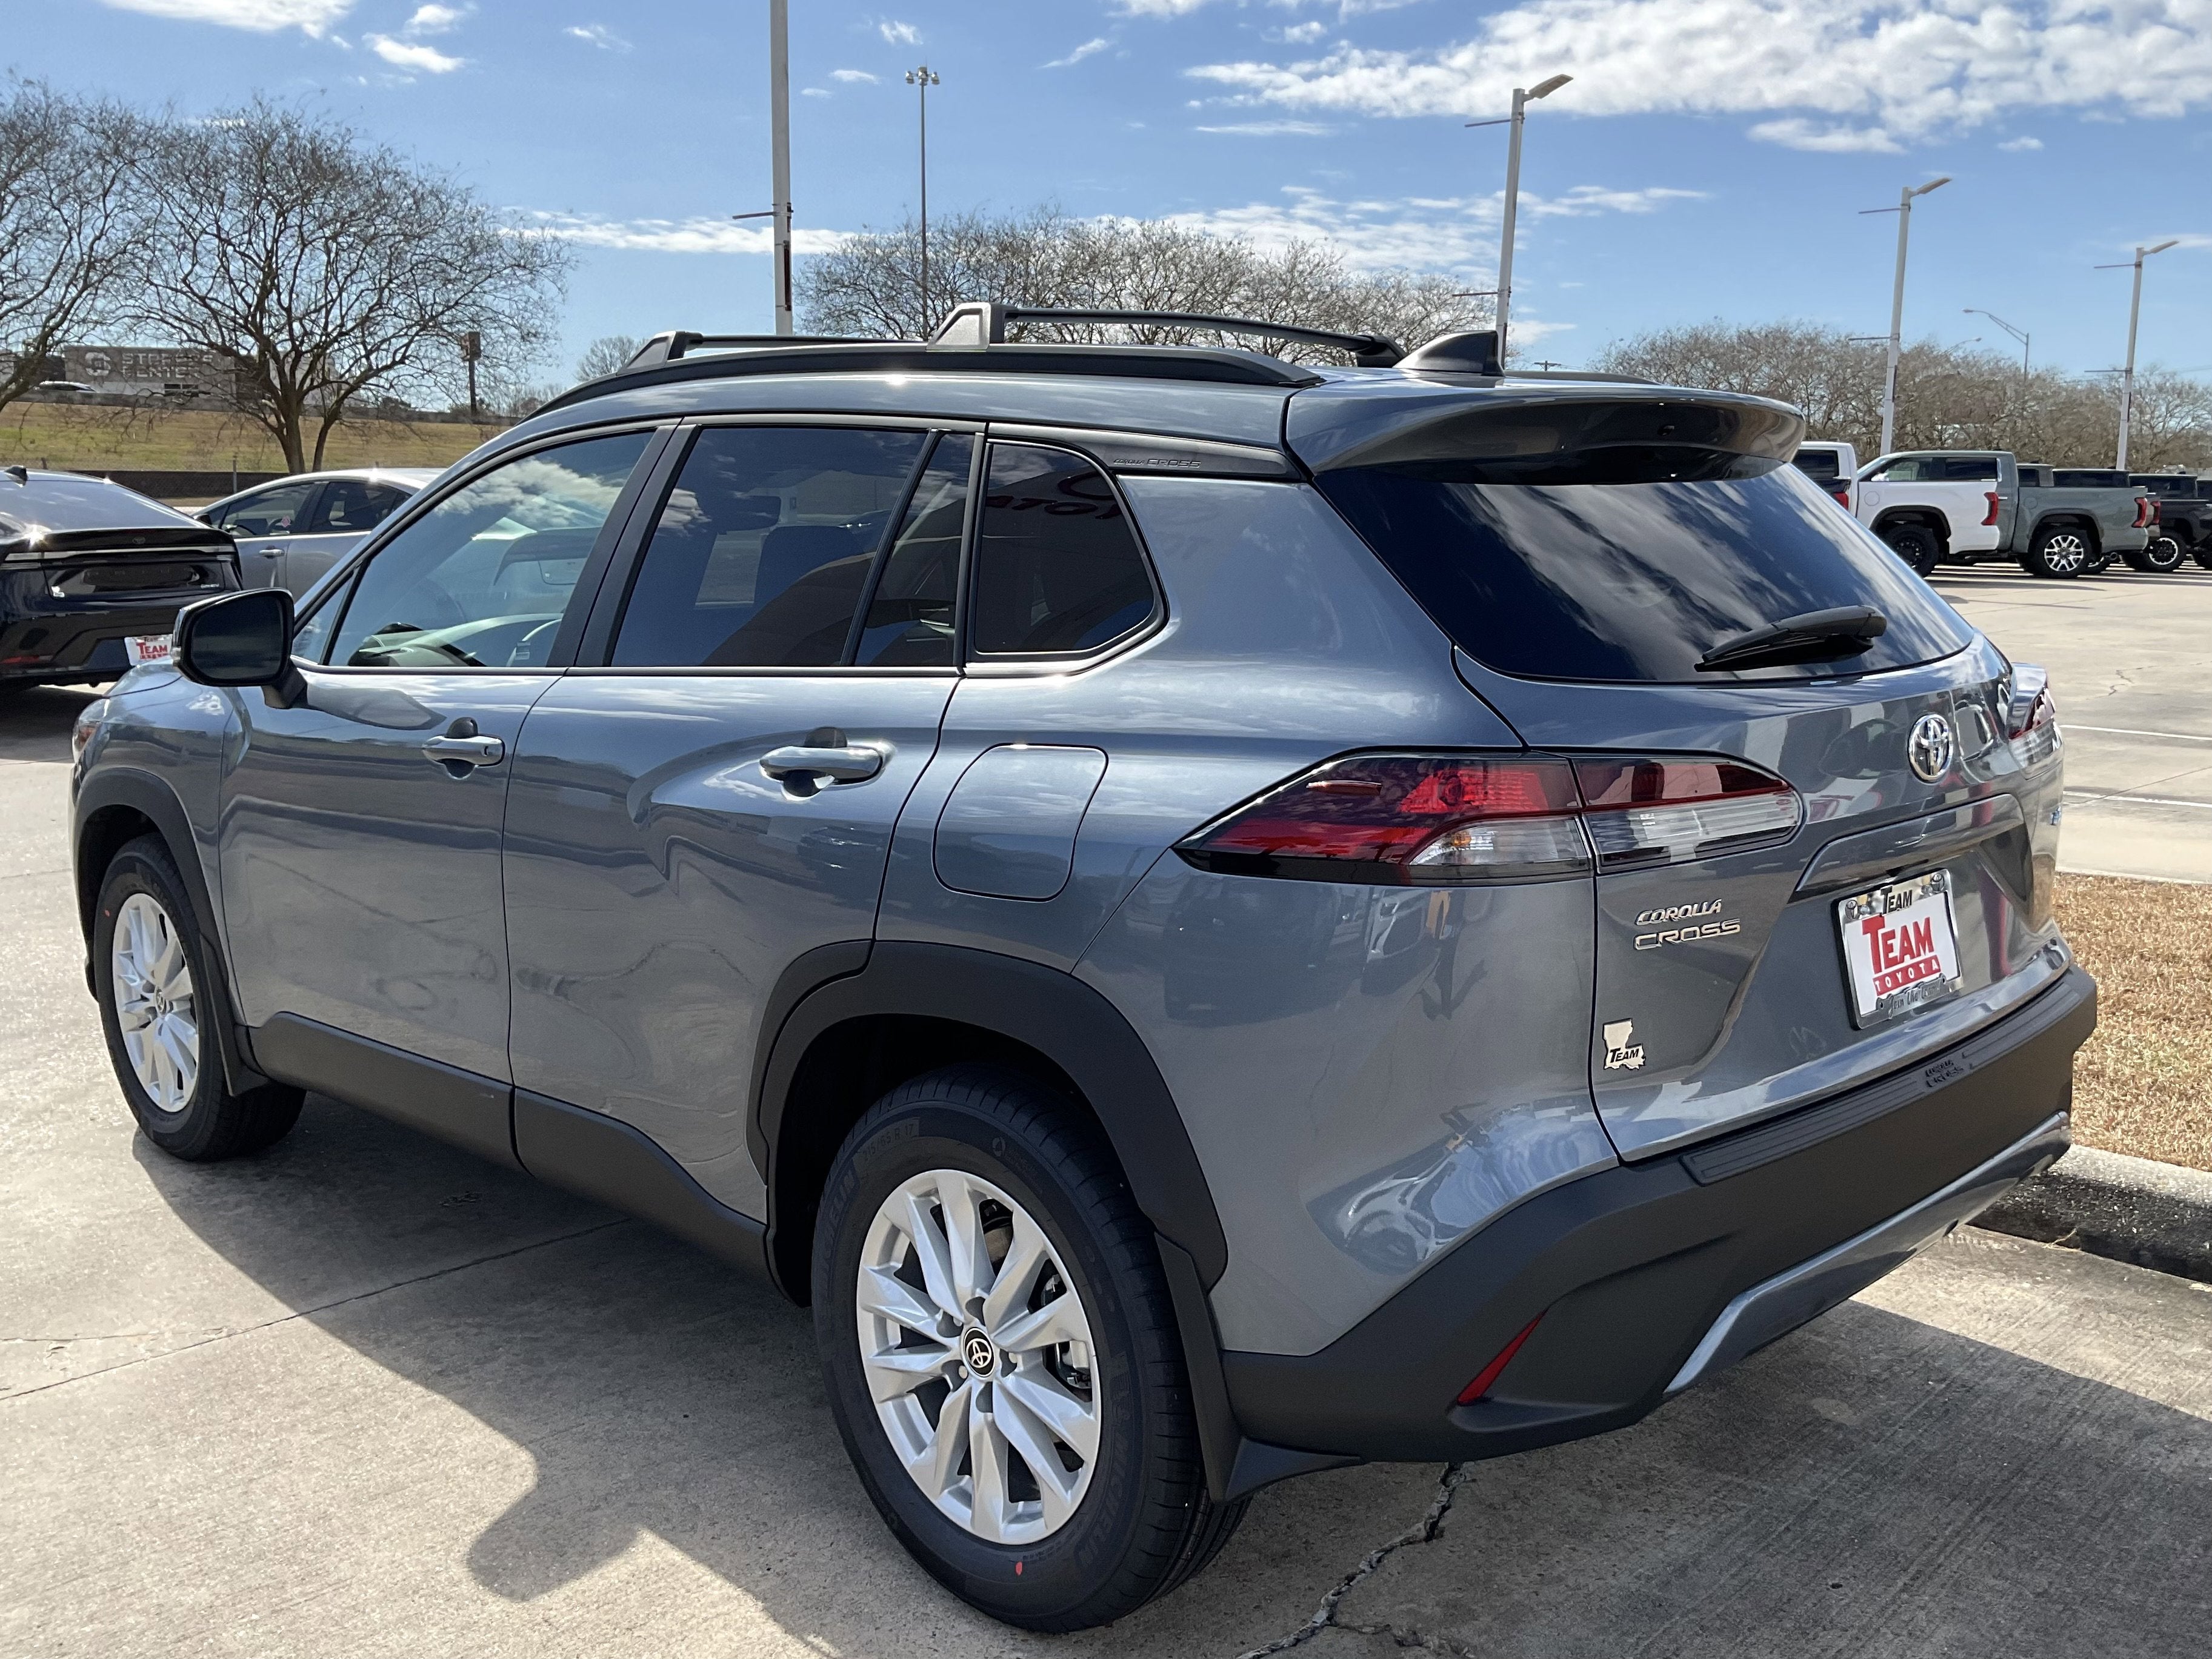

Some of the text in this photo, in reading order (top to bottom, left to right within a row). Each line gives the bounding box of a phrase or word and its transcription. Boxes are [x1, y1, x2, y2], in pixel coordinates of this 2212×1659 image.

[1147, 458, 1202, 469] CROSS
[136, 642, 168, 654] TEAM
[1635, 898, 1722, 926] COROLLA
[1881, 885, 1913, 914] TEAM
[1633, 918, 1741, 951] CROSS
[1862, 915, 1934, 974] TEAM
[1875, 959, 1939, 992] TOYOTA
[1610, 1048, 1639, 1063] TEAM
[905, 1123, 914, 1136] 17
